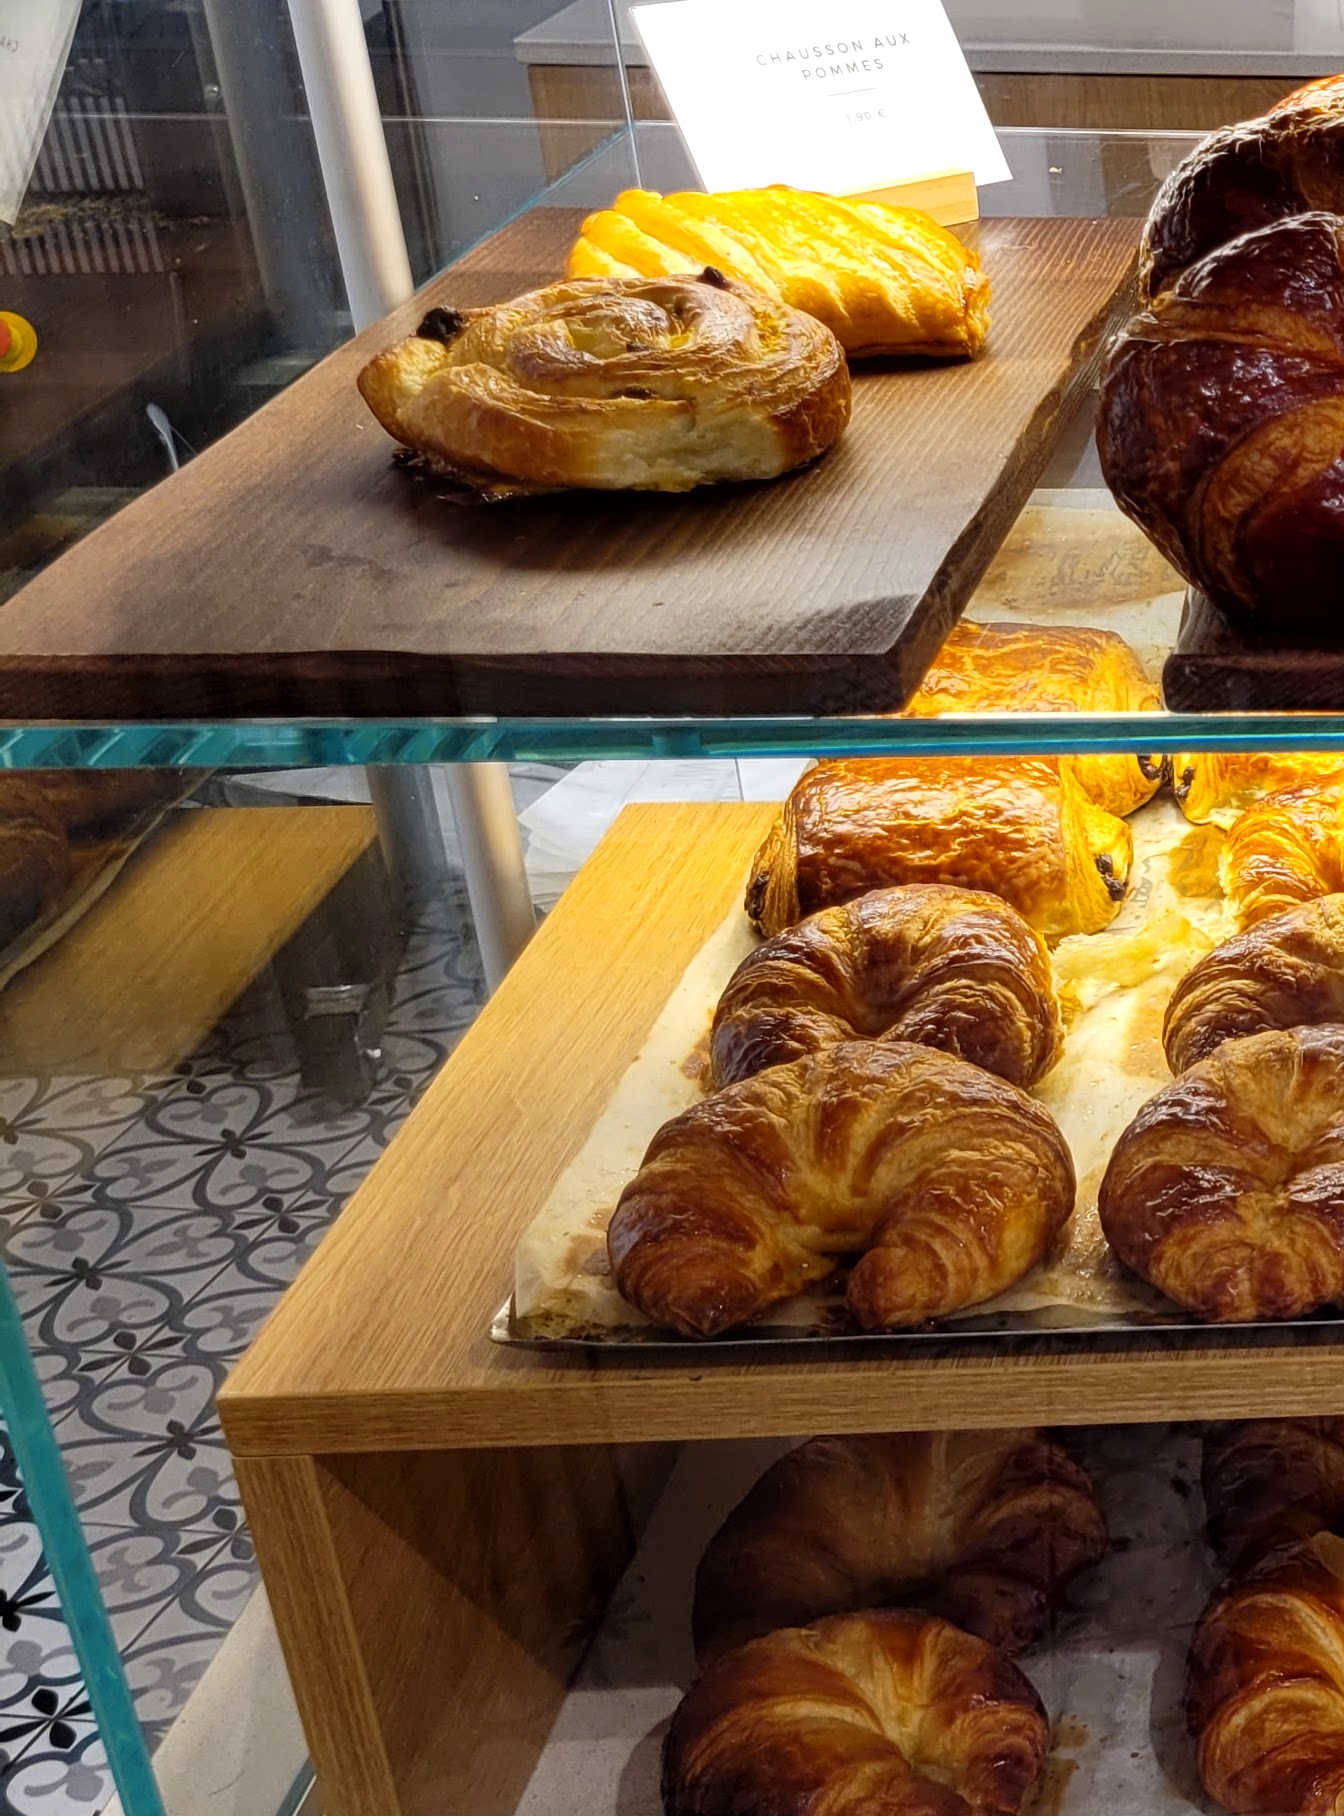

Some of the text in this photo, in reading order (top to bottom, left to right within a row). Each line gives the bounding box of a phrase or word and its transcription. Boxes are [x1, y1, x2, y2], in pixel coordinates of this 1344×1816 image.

[756, 33, 911, 66] CHAUSSON AUX
[802, 59, 884, 80] POMMES
